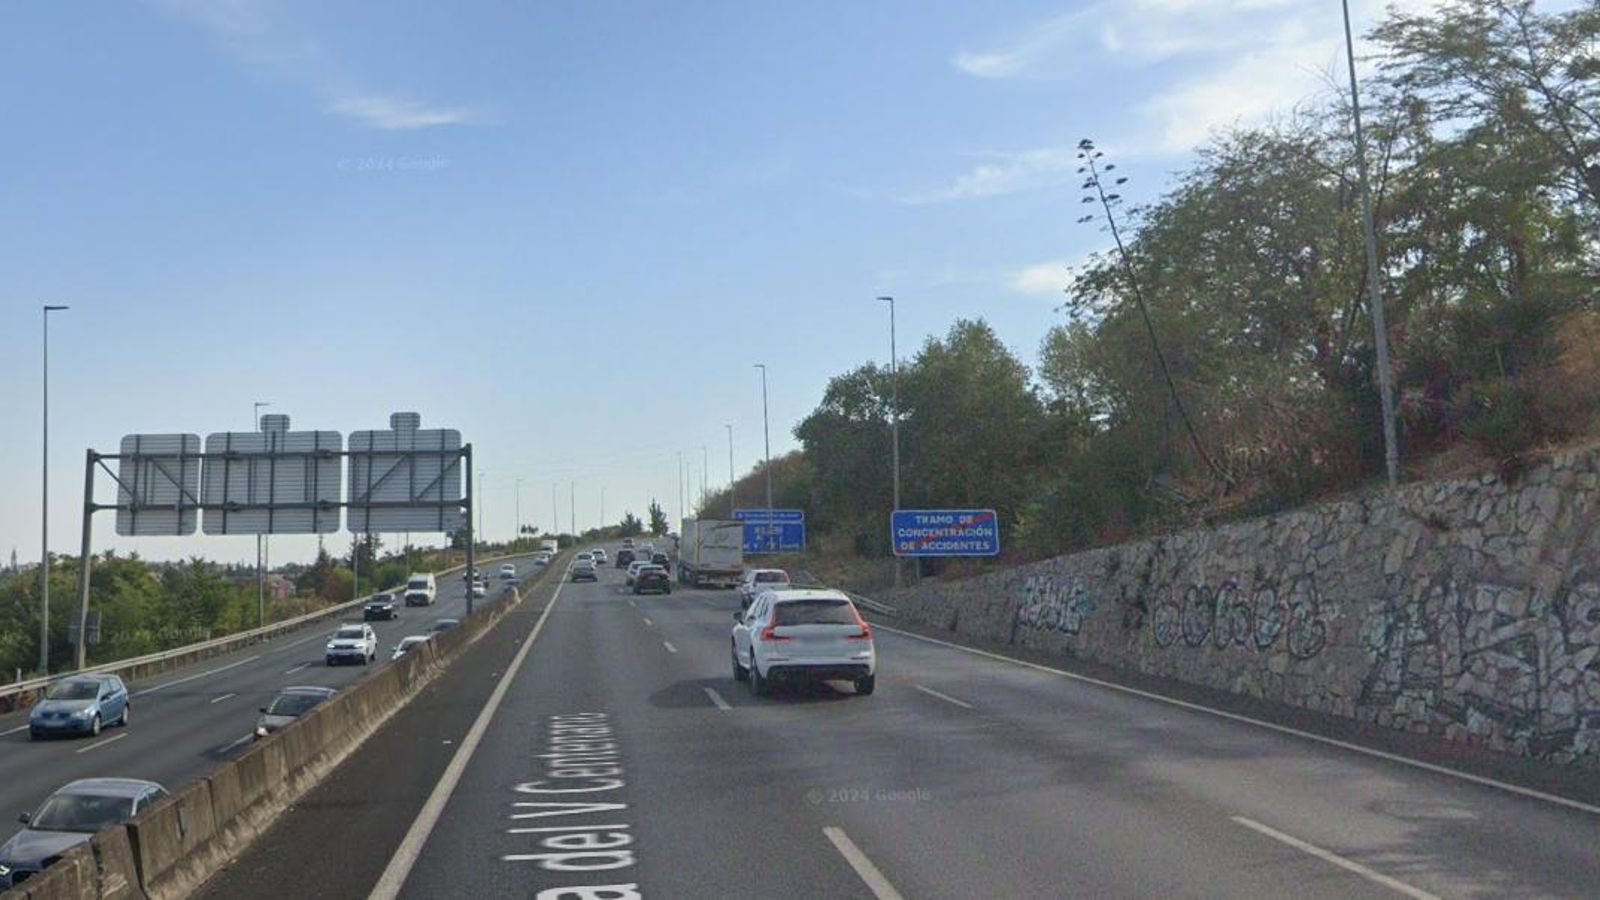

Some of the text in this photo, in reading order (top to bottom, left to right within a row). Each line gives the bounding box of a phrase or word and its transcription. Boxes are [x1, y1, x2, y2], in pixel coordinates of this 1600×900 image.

[915, 515, 975, 524] TRAMO DE
[898, 525, 993, 537] CONCENTRACIÓN
[901, 541, 990, 550] DE ACCIDENTES
